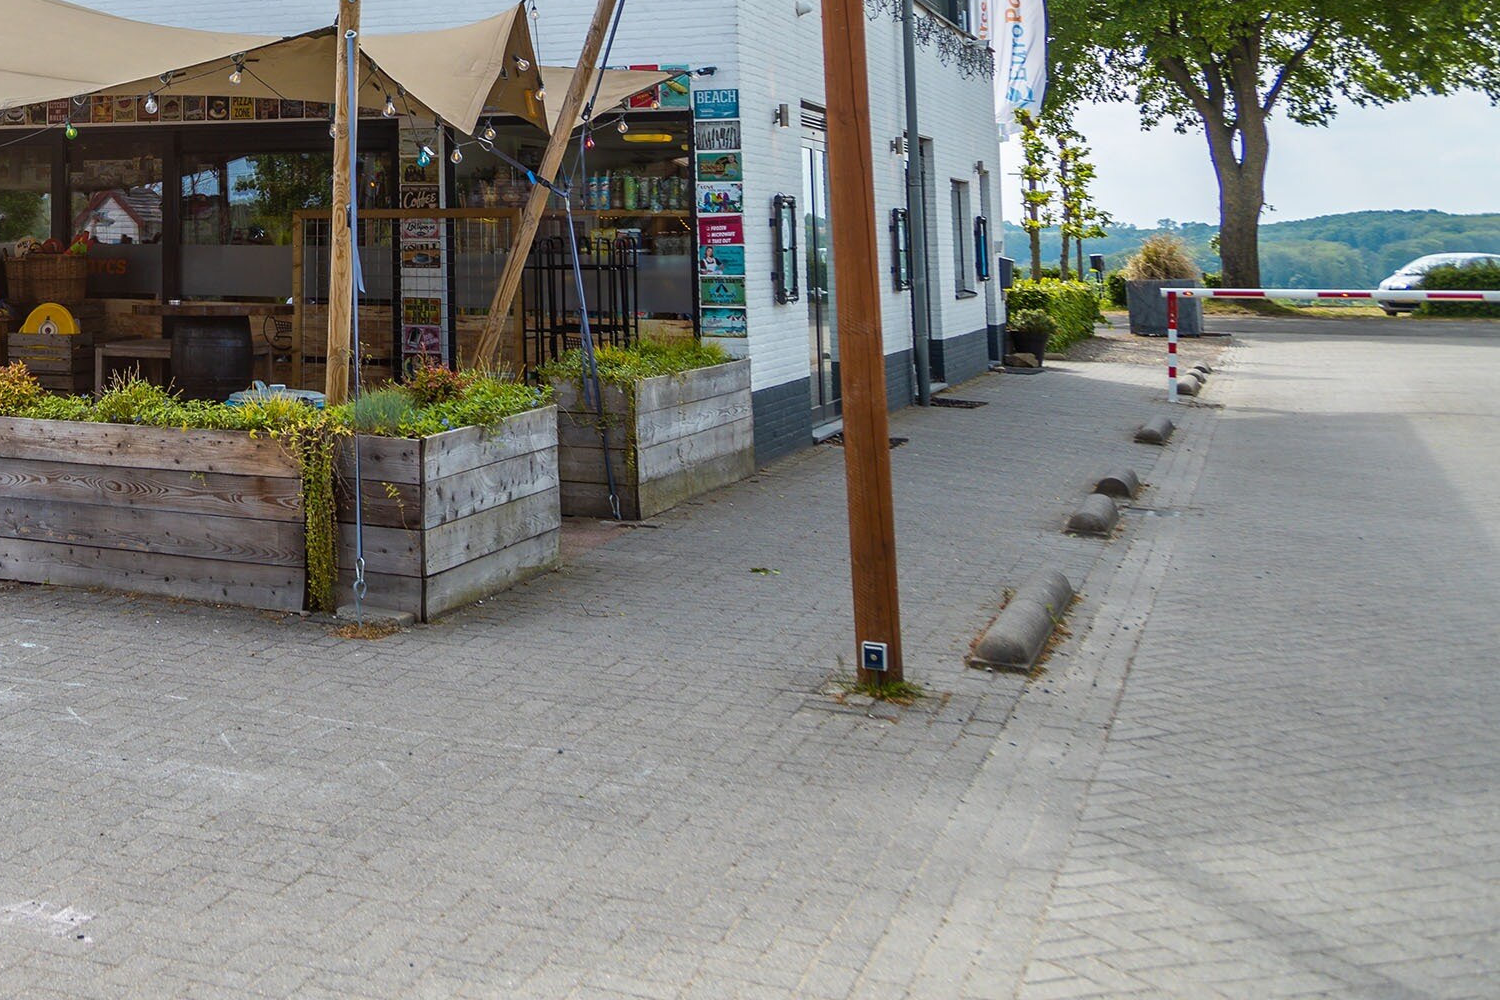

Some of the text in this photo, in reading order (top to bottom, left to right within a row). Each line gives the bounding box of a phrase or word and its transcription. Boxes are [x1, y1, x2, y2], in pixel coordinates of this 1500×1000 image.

[232, 96, 253, 106] PIZZA
[696, 90, 737, 104] BEACH
[235, 107, 251, 118] ZONE
